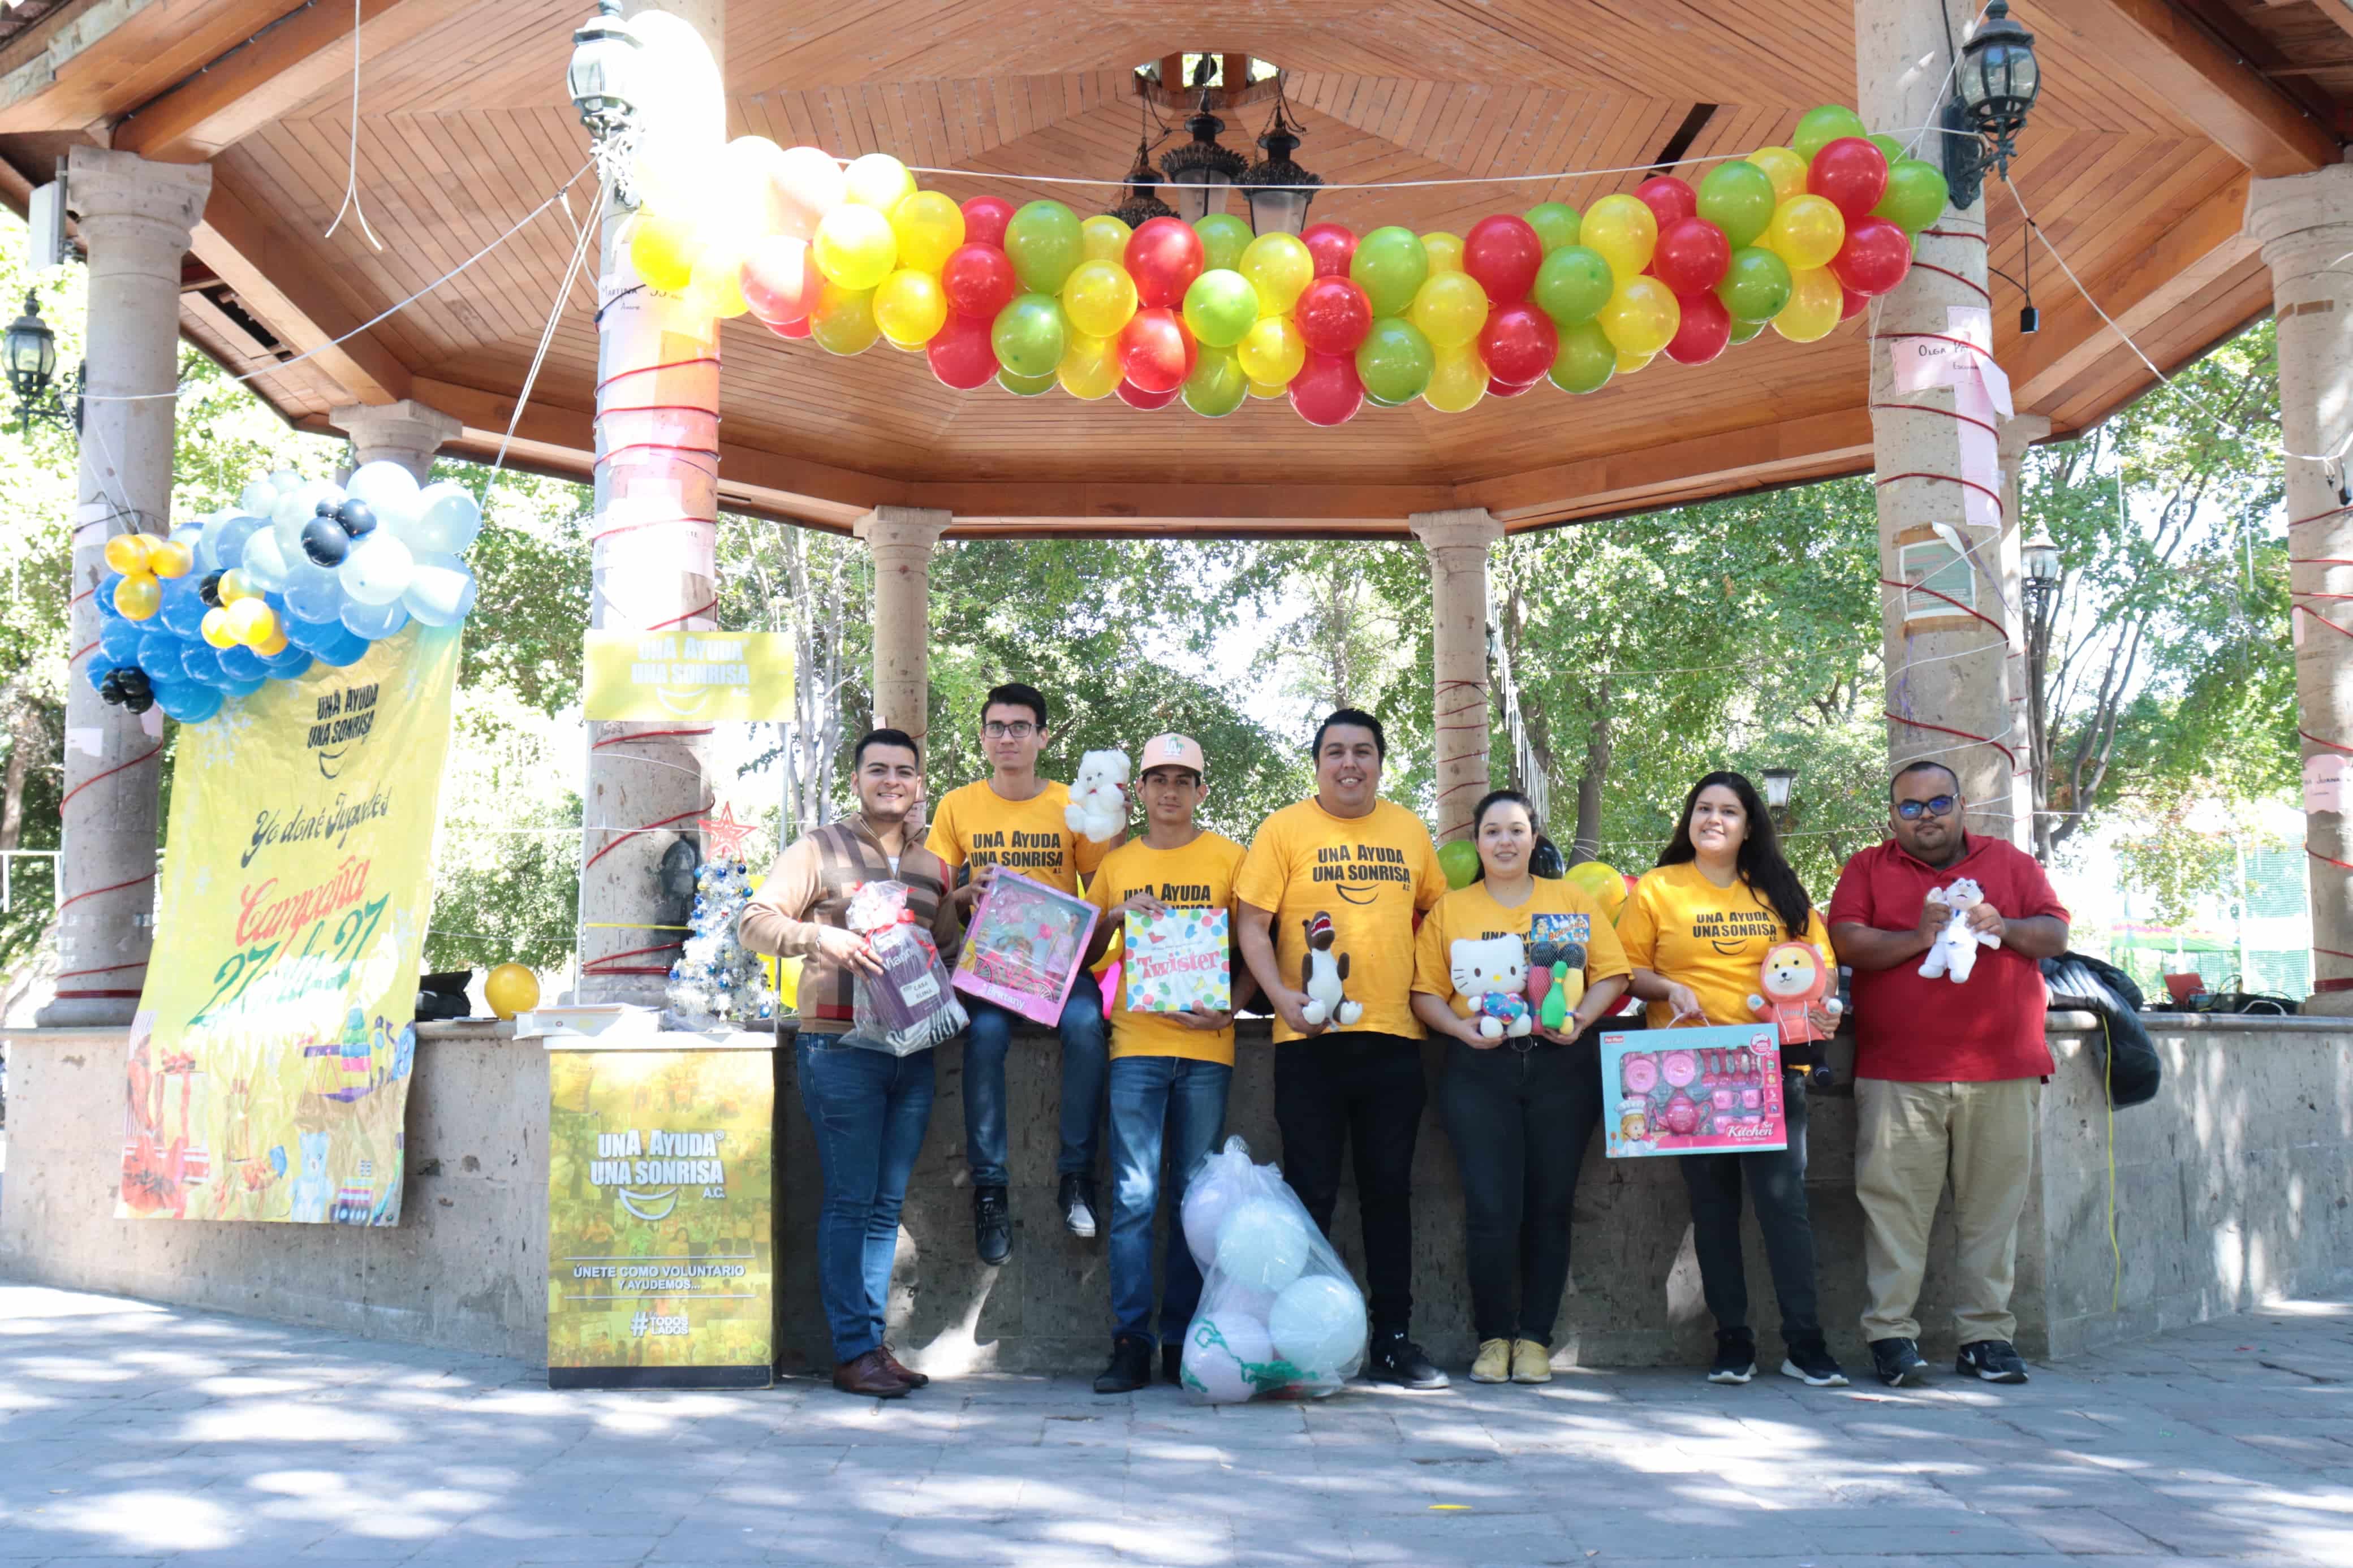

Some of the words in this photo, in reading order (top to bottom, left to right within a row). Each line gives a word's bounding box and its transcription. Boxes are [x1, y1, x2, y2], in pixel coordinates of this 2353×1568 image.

[1919, 344, 1946, 356] OLGA
[637, 636, 677, 660] UNA
[683, 636, 744, 661] AYUDA
[631, 663, 668, 684] UNA
[671, 663, 751, 685] SONRISA
[317, 689, 341, 720] UNA
[344, 683, 379, 713] AYUDA
[307, 723, 331, 749] UNA
[331, 710, 374, 744] SONRISA
[241, 809, 281, 869] Yo
[279, 805, 326, 843] doné
[973, 831, 1005, 849] UNA
[1011, 831, 1061, 848] AYUDA
[971, 852, 998, 867] UNA
[1001, 851, 1063, 867] SONRISA
[1318, 845, 1351, 863] UNA
[1358, 844, 1406, 864] AYUDA
[1313, 865, 1346, 882] UNA
[1348, 865, 1411, 883] SONRISA
[1161, 883, 1211, 901] AYUDA
[235, 854, 371, 962] Campaña
[1696, 912, 1724, 923] UNA
[1729, 912, 1771, 922] AYUDA
[1693, 925, 1721, 938] UNA
[1721, 924, 1777, 936] SONRISA
[1136, 950, 1221, 979] Twister
[985, 984, 1025, 1010] Brittany
[1728, 1124, 1774, 1138] Kitchen
[598, 1130, 642, 1158] UNA
[649, 1130, 717, 1157] AYUDA
[590, 1160, 632, 1185] UNA
[635, 1160, 725, 1185] SONRISA
[703, 1187, 726, 1198] A.C.
[573, 1264, 617, 1278] ÚNETE
[619, 1266, 659, 1277] COMO
[661, 1265, 746, 1277] VOLUNTARIO
[618, 1280, 627, 1290] Y
[650, 1316, 688, 1325] TODOS
[651, 1325, 688, 1335] LADOS
